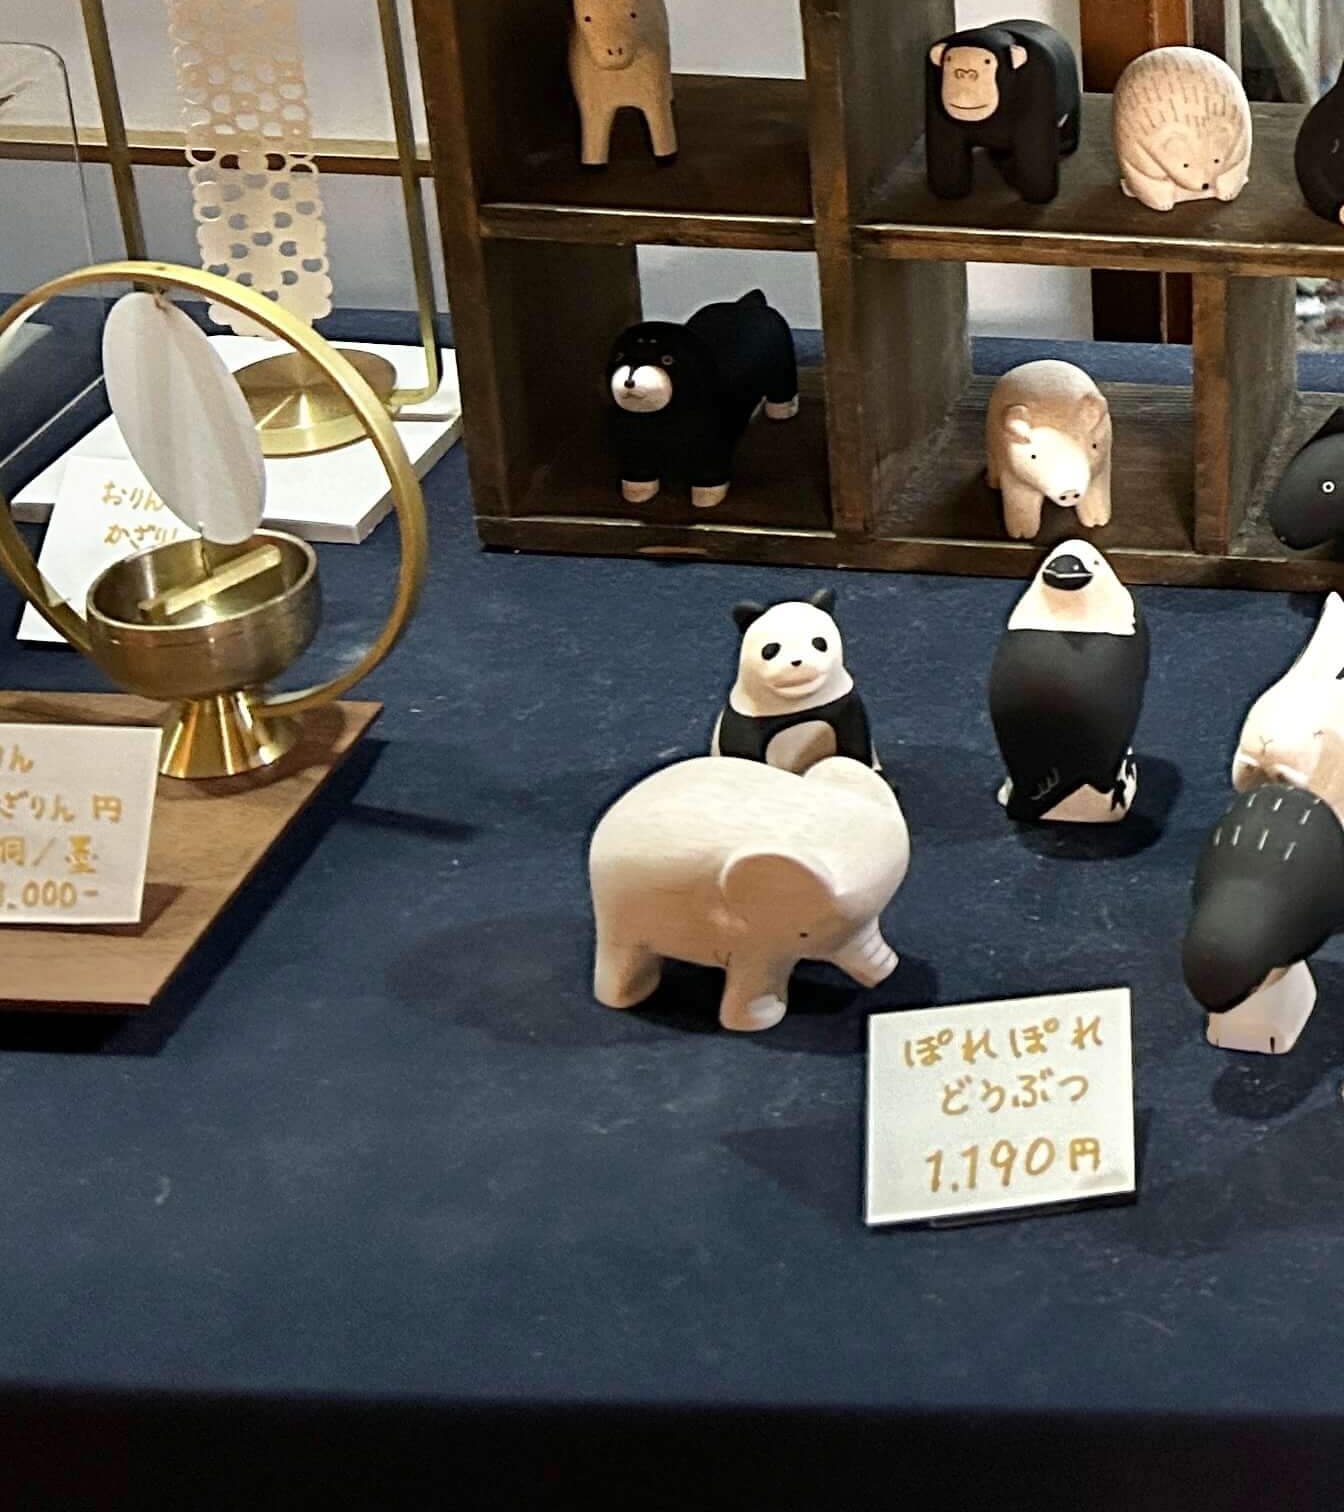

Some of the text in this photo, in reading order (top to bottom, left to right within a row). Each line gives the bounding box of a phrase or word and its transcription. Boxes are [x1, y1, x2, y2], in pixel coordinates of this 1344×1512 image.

[0, 743, 34, 774] ん
[91, 793, 123, 824] 円
[904, 1016, 1103, 1067] ぽれぽれ
[941, 1067, 1089, 1116] どうぶつ
[925, 1137, 1101, 1193] 1.190円
